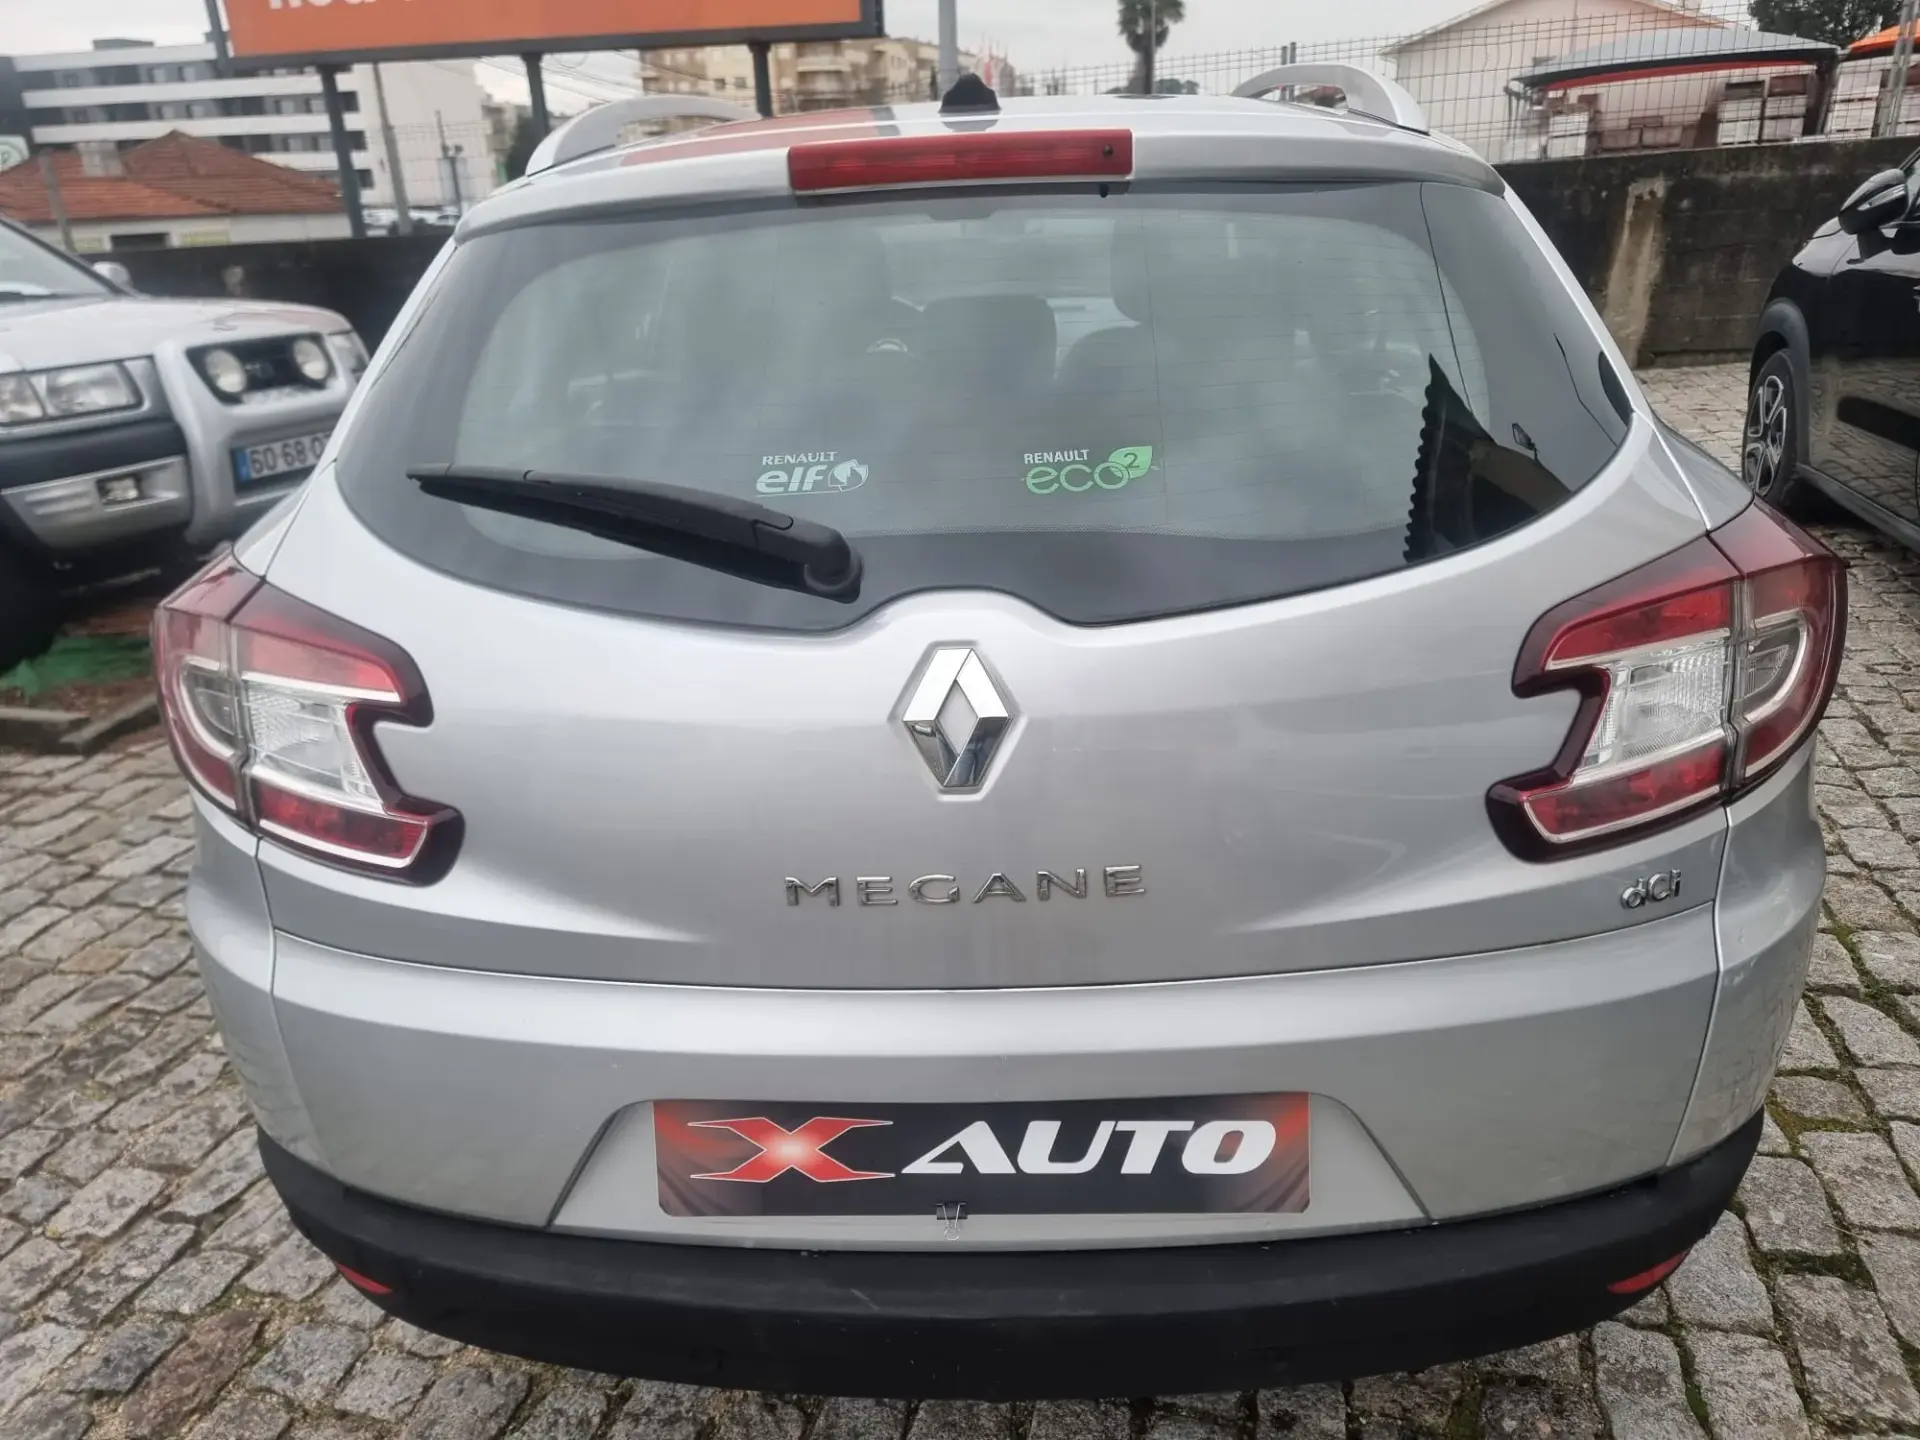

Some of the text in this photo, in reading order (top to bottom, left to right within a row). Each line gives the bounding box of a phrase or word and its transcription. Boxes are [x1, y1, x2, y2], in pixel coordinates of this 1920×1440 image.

[762, 451, 838, 466] RENAULT
[1023, 449, 1090, 465] RENAULT
[756, 464, 829, 494] elf
[784, 864, 1146, 908] MEGANE
[687, 1115, 1278, 1184] X AUTO
